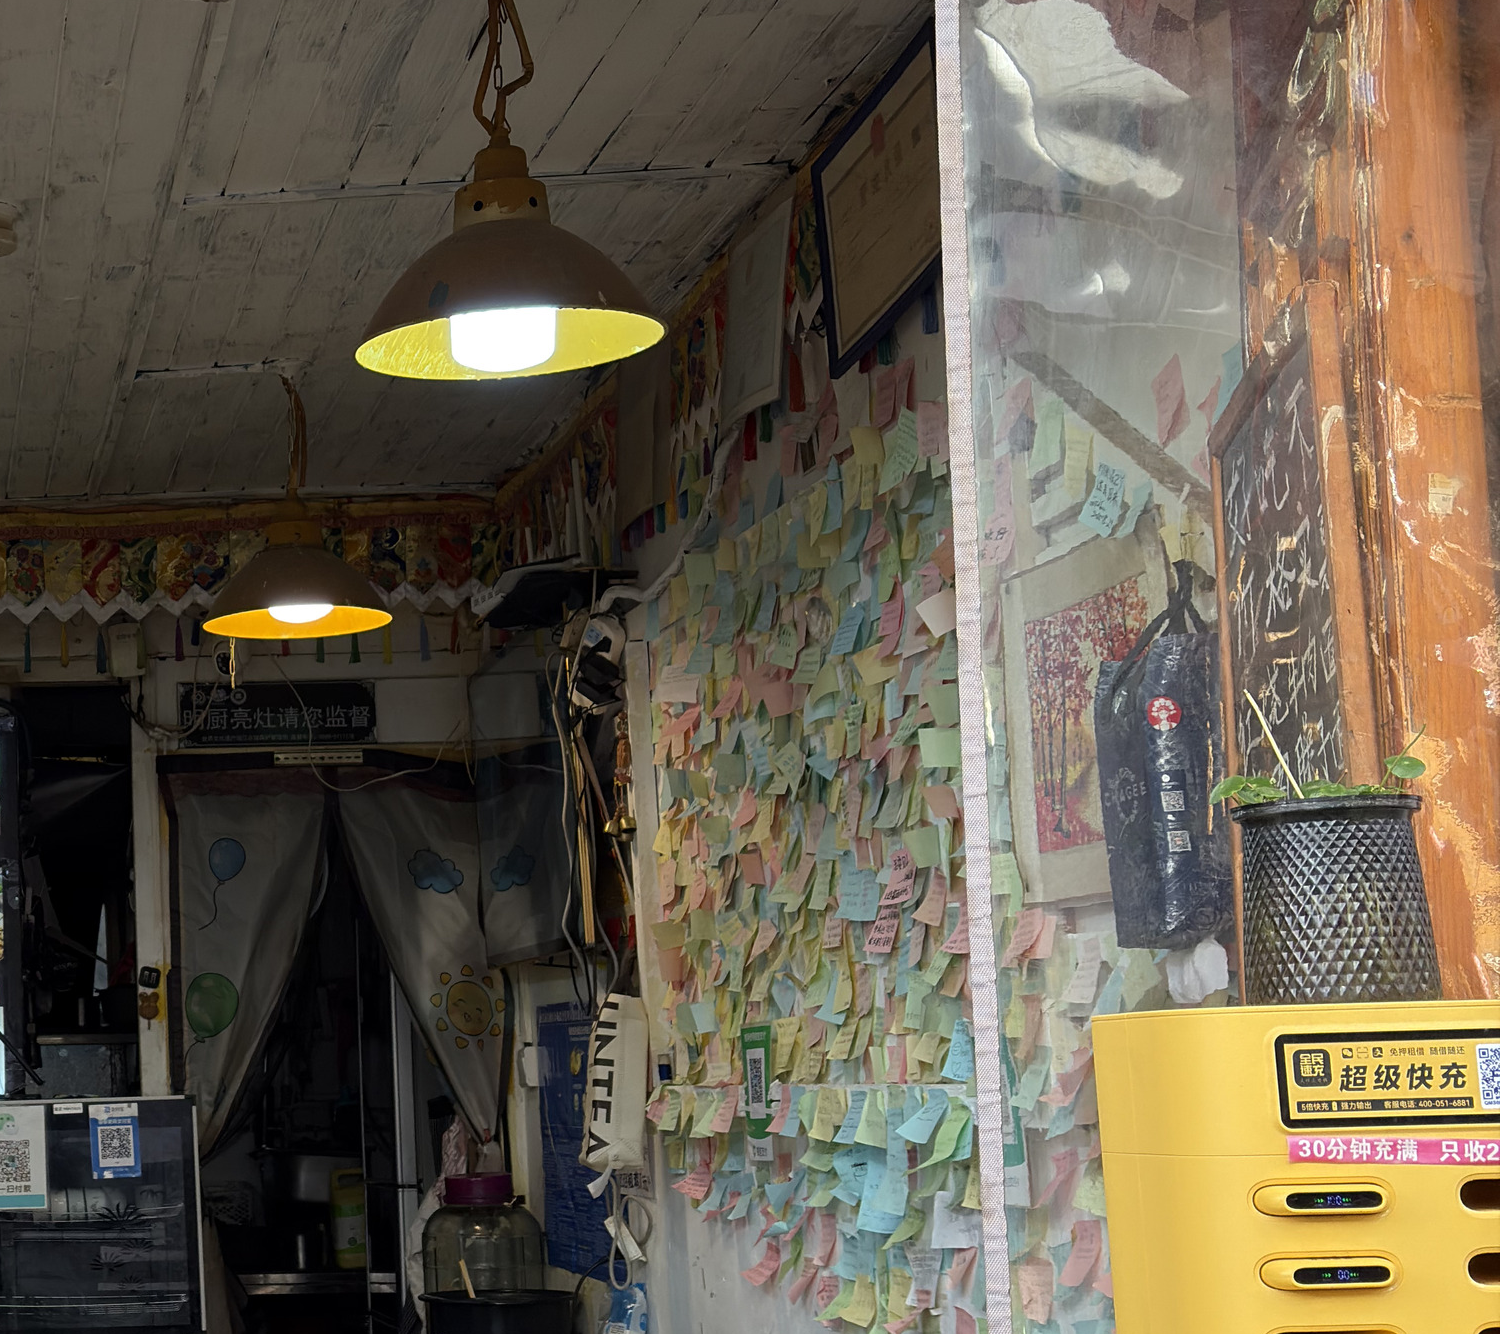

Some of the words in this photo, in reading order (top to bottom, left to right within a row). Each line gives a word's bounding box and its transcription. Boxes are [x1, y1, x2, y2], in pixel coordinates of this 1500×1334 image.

[183, 705, 371, 730] 明厨亮灶请您监督
[1299, 1052, 1325, 1065] 全民
[1339, 1062, 1468, 1093] 超级快充
[1298, 1139, 1419, 1162] 30分钟充满
[1440, 1140, 1500, 1162] 只收2
